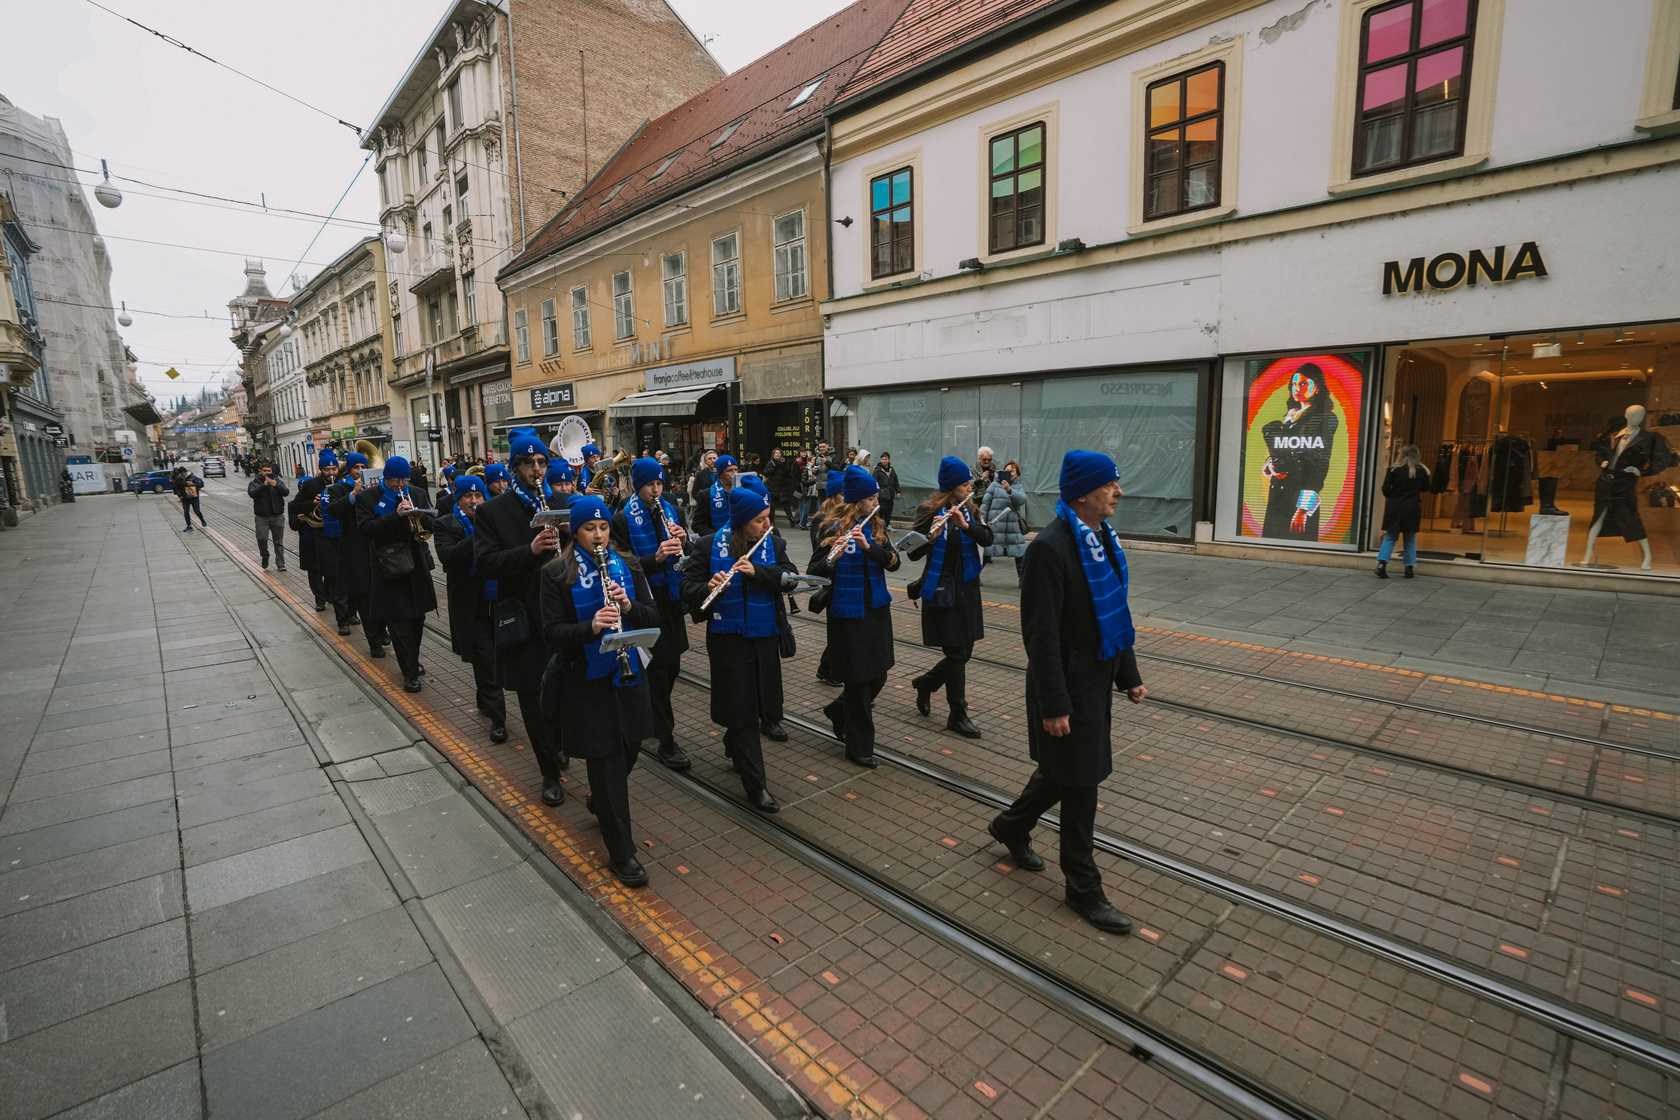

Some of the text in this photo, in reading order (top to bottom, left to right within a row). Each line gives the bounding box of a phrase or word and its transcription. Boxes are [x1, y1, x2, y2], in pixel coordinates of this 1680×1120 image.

[1382, 241, 1548, 295] MONA
[542, 387, 570, 406] alpina
[1273, 435, 1325, 450] MONA
